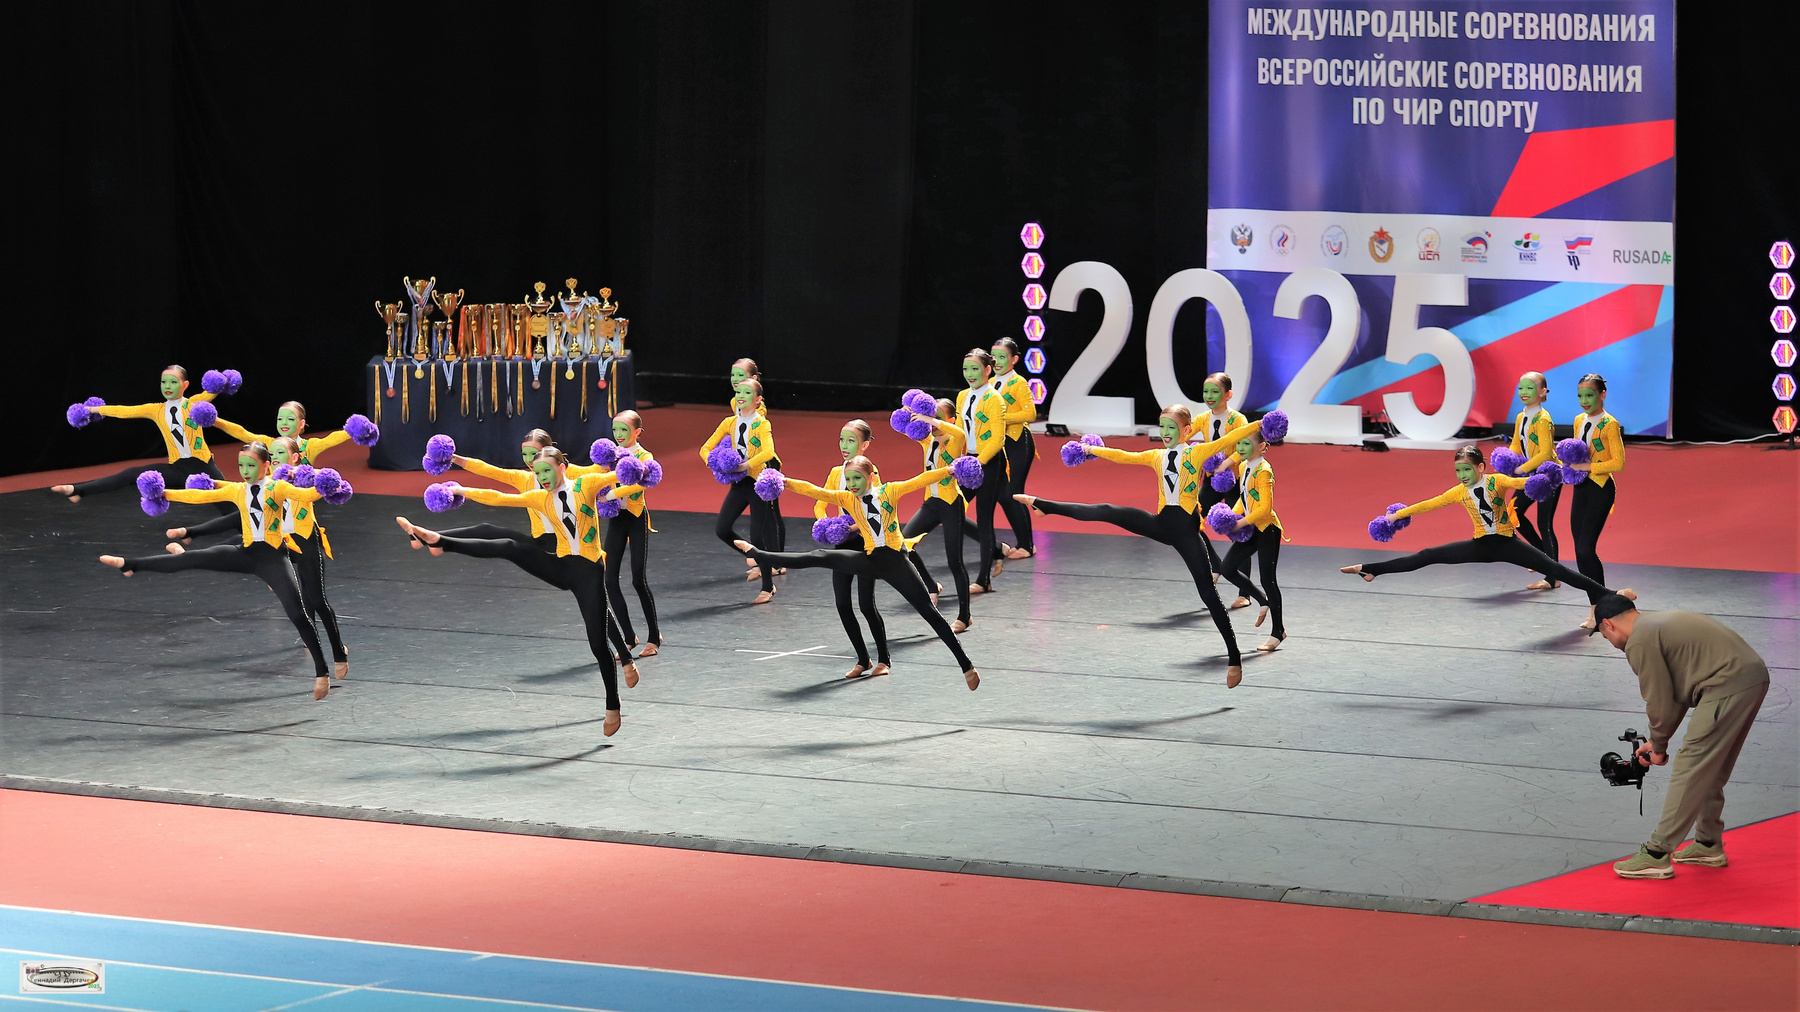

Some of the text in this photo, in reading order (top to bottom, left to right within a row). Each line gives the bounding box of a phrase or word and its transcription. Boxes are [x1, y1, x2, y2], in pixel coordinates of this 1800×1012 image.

[1247, 7, 1655, 42] МЕЖДУНАРОДНЫЕ СОРЕВНОВАНИЯ
[1258, 53, 1642, 93] ВСЕРОССИЙСКИЕ СОРЕВНОВАНИЯ
[1352, 97, 1539, 133] ПО ЧИР СПОРТУ
[1612, 248, 1672, 265] RUSADA
[1048, 260, 1476, 442] 2025
